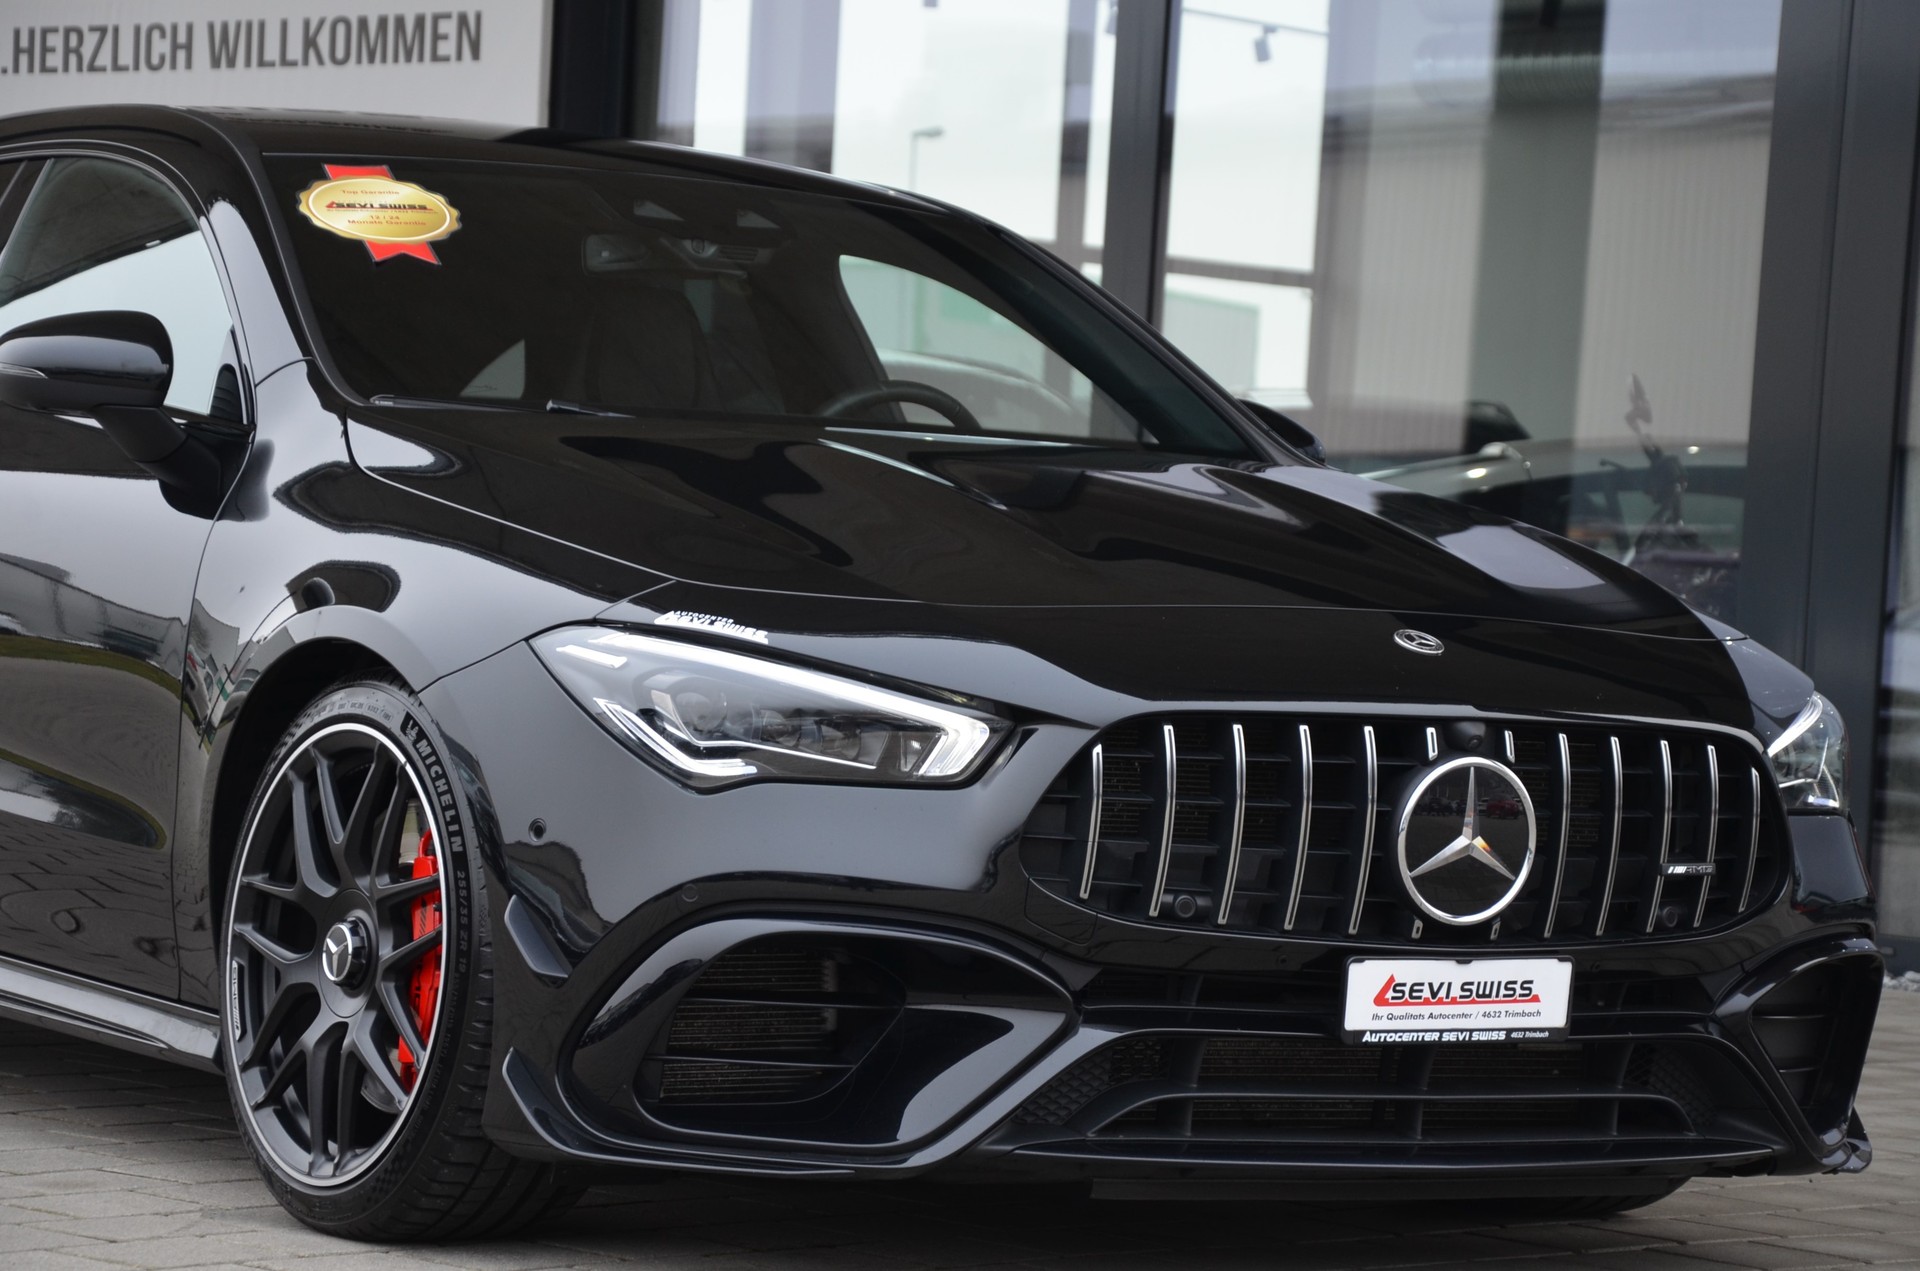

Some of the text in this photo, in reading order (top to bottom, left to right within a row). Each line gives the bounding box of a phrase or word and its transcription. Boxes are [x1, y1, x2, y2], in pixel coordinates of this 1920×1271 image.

[206, 10, 483, 70] WILLKOMMEN
[674, 611, 734, 624] AUTOCENTER
[415, 738, 463, 852] MICHELIN
[1391, 979, 1534, 1001] SEVI SWISS
[1371, 1013, 1383, 1021] Ihr
[1386, 1012, 1425, 1021] Qualitats
[1427, 1011, 1472, 1020] Autocenter
[1482, 1010, 1501, 1019] 4632
[1504, 1009, 1541, 1018] Trimbach
[1362, 1030, 1440, 1043] AUTOCENTER
[1441, 1031, 1471, 1042] SEVI
[1471, 1030, 1506, 1041] SWISS
[1525, 1030, 1549, 1038] Trimbach
